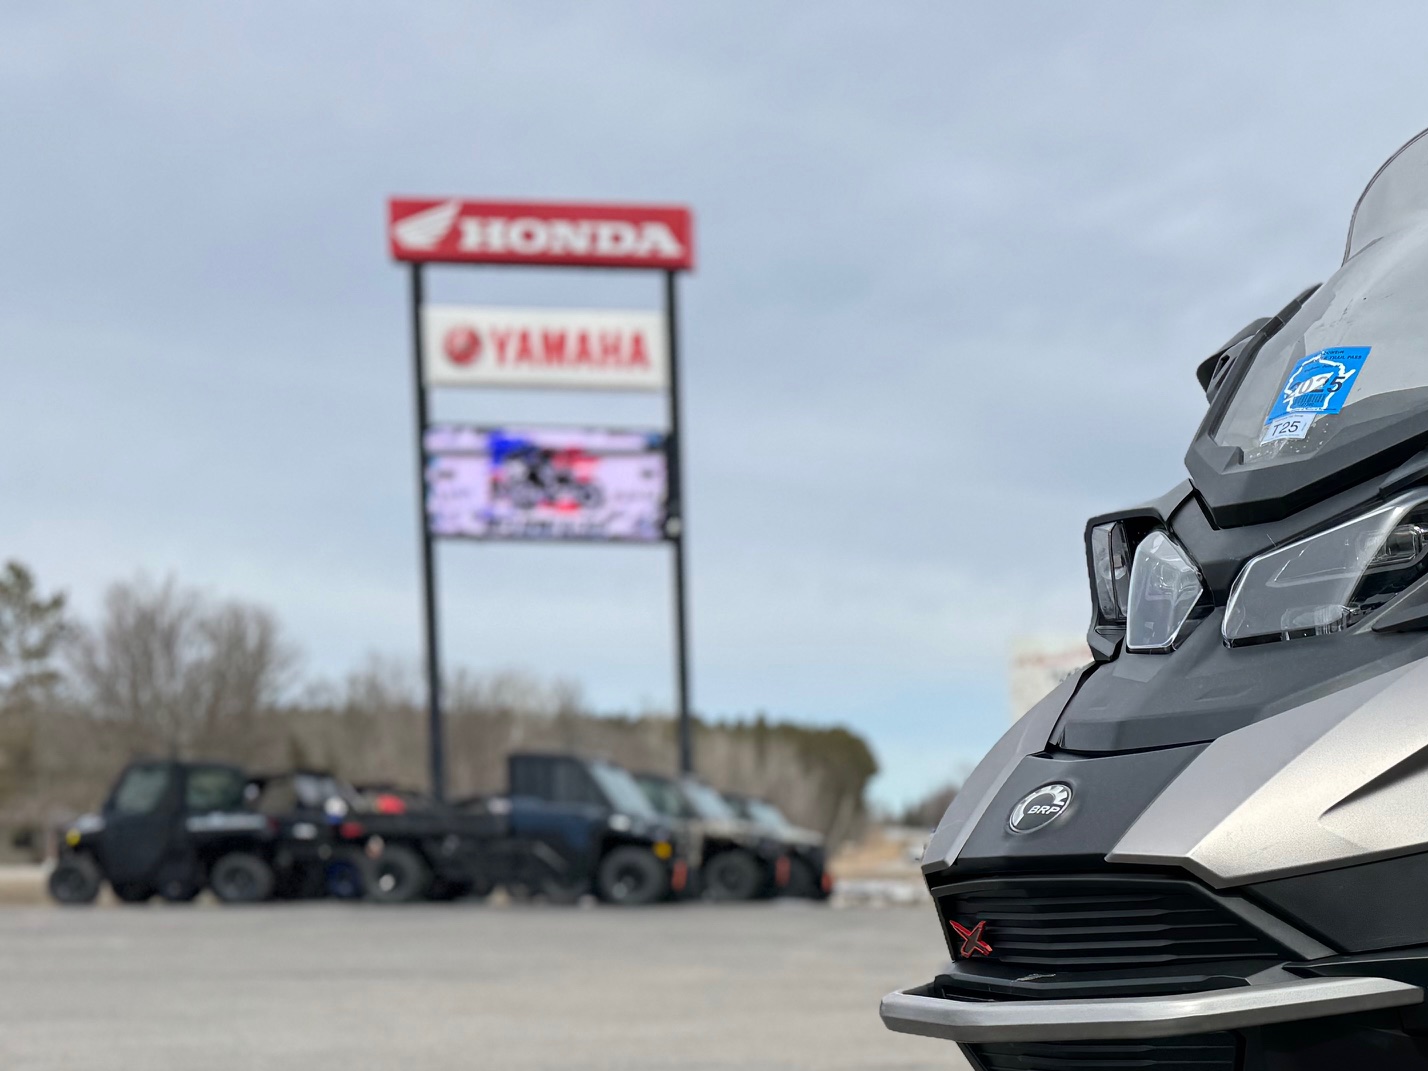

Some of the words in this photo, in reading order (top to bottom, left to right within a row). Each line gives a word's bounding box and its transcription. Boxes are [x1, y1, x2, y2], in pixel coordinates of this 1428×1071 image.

[458, 215, 686, 260] HONDA
[488, 328, 652, 370] YAMAHA
[1286, 375, 1346, 400] 2025
[1272, 421, 1301, 436] T25
[1027, 805, 1061, 815] BRP
